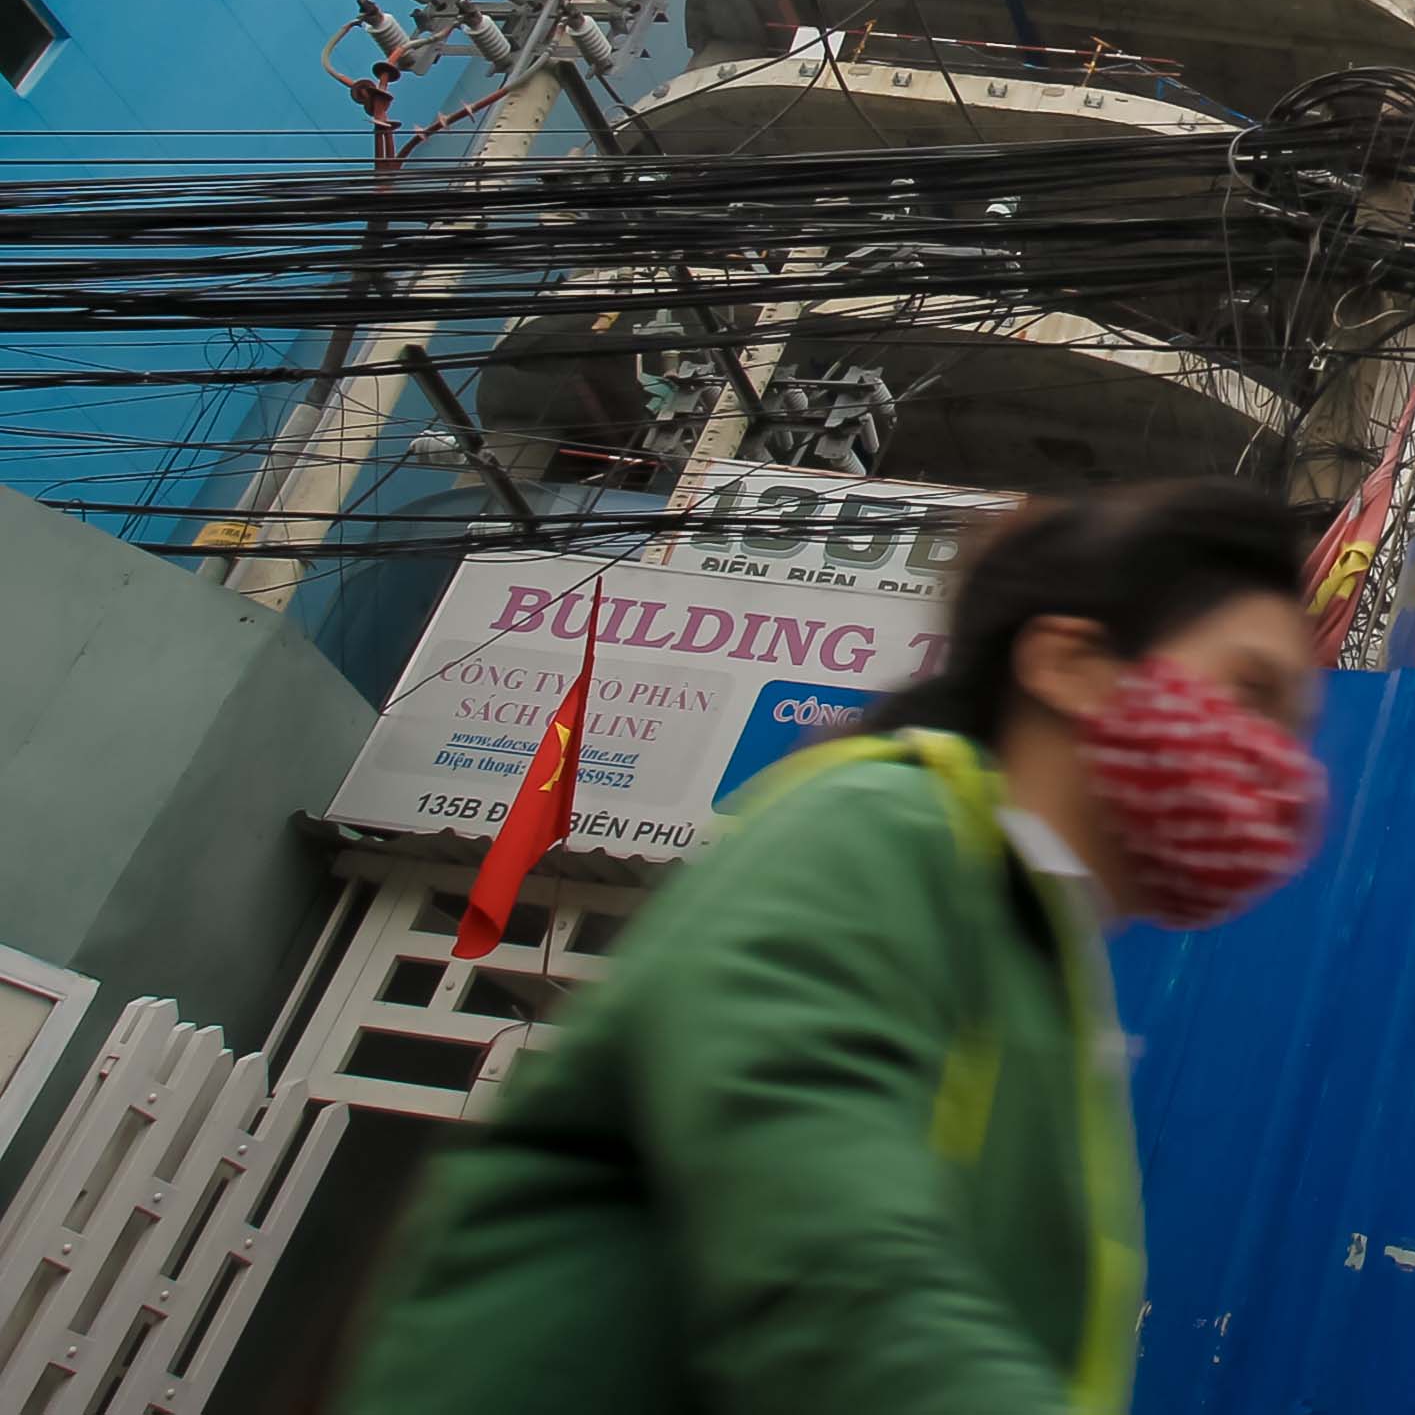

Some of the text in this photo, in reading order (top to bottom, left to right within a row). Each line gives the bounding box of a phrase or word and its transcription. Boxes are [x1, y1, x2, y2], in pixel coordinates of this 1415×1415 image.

[489, 584, 878, 674] BUILDING
[440, 658, 529, 691] CÔNG
[454, 693, 663, 742] SÁCH LINE
[433, 749, 475, 772] Điện
[416, 792, 482, 820] 135B
